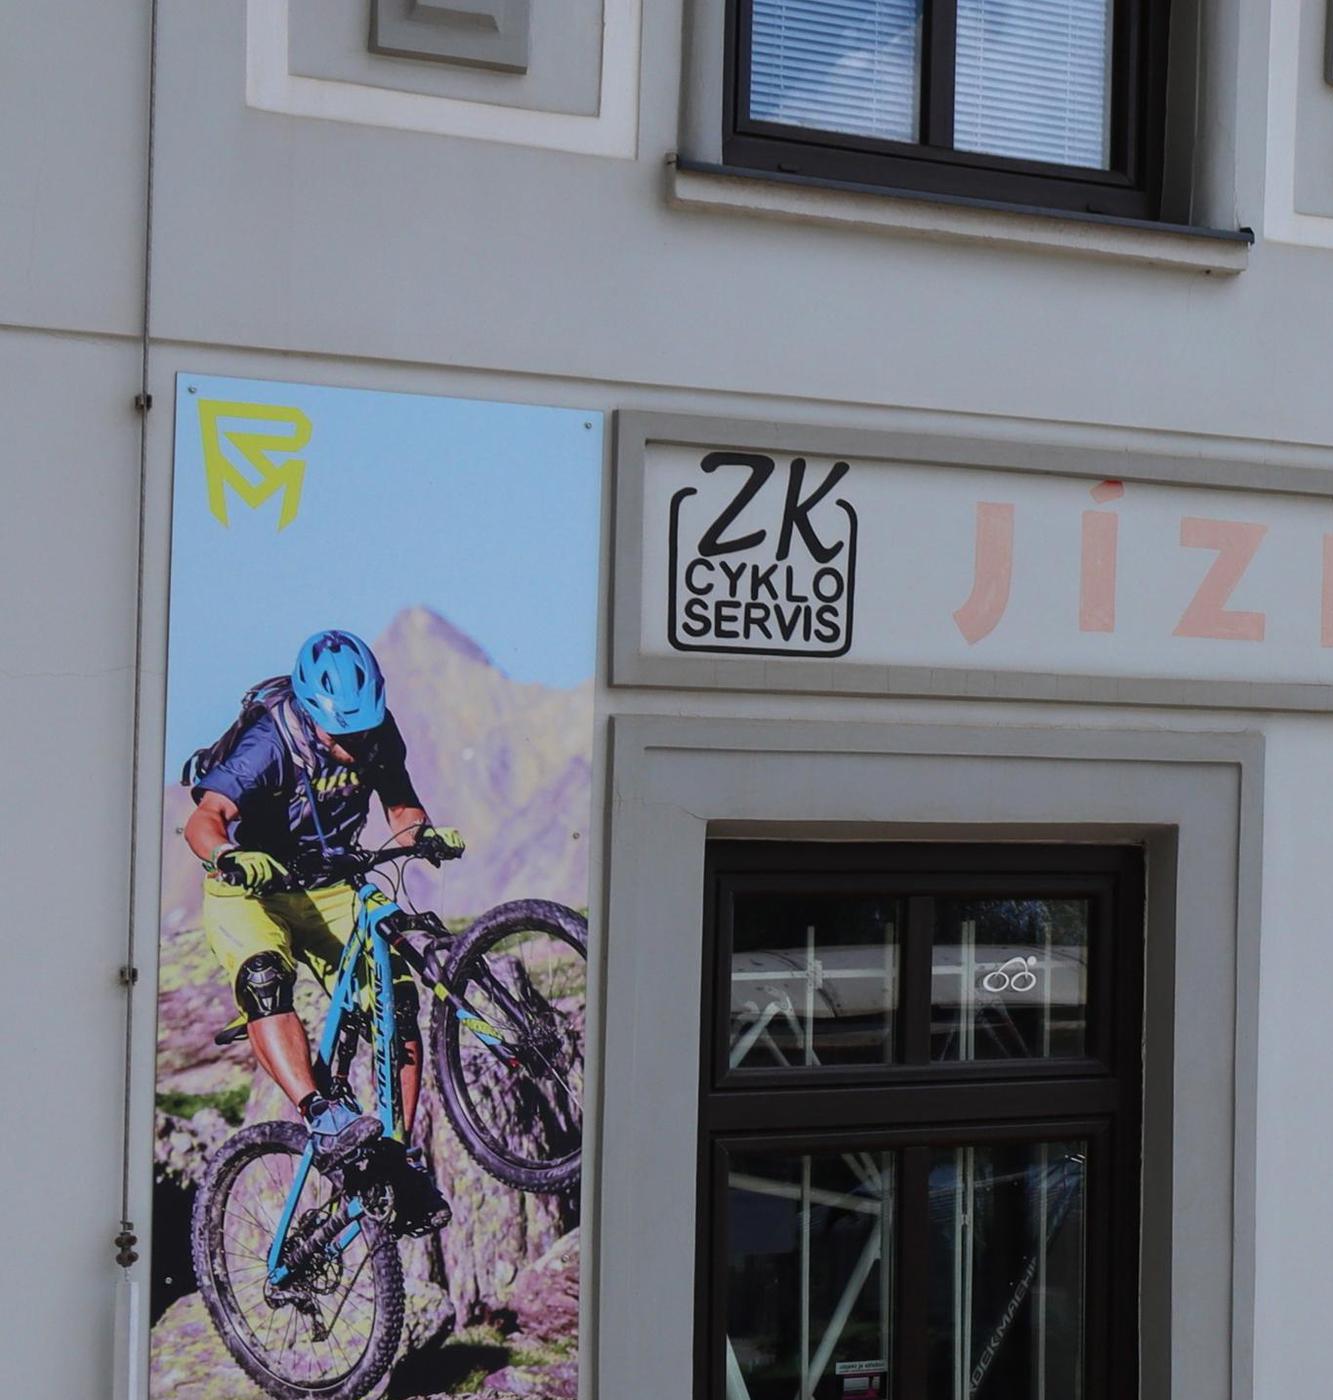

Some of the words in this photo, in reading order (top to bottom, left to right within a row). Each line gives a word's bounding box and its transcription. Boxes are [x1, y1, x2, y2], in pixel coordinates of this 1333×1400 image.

[698, 451, 850, 564] ZK
[684, 557, 845, 604] CYKLO
[681, 599, 842, 644] SERVIS
